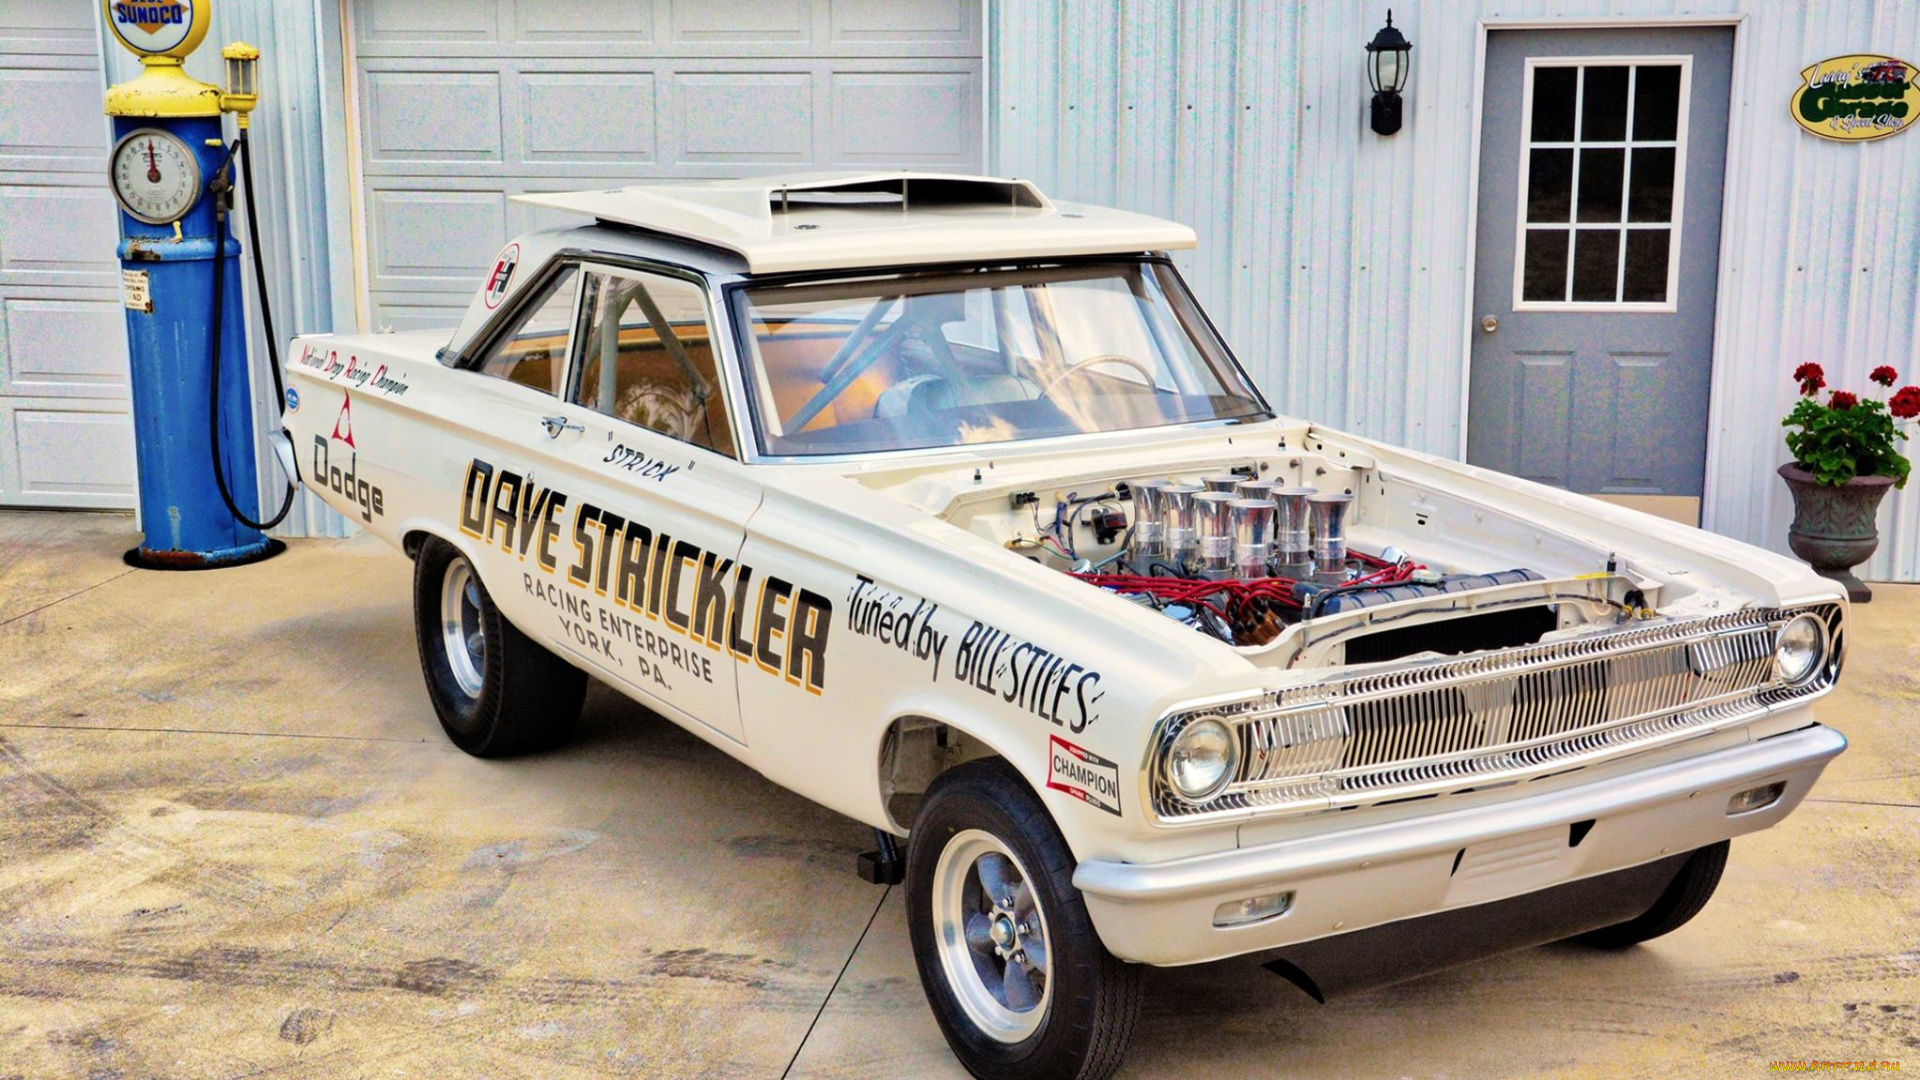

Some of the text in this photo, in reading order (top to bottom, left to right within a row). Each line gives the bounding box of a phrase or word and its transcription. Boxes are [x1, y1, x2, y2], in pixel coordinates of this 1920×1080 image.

[117, 2, 183, 24] SUNOCO
[1809, 63, 1865, 89] Larry's
[1874, 113, 1905, 133] Shop
[300, 344, 409, 396] National Drag Racing Champion
[314, 433, 384, 523] Dodge
[459, 457, 833, 697] DAVE STRICKLER
[523, 572, 714, 684] RACING ENTERPRISE
[558, 615, 673, 691] YORK, PA.
[847, 573, 1101, 734] Tuned by BILL STILES
[1053, 754, 1117, 799] CHAMPION
